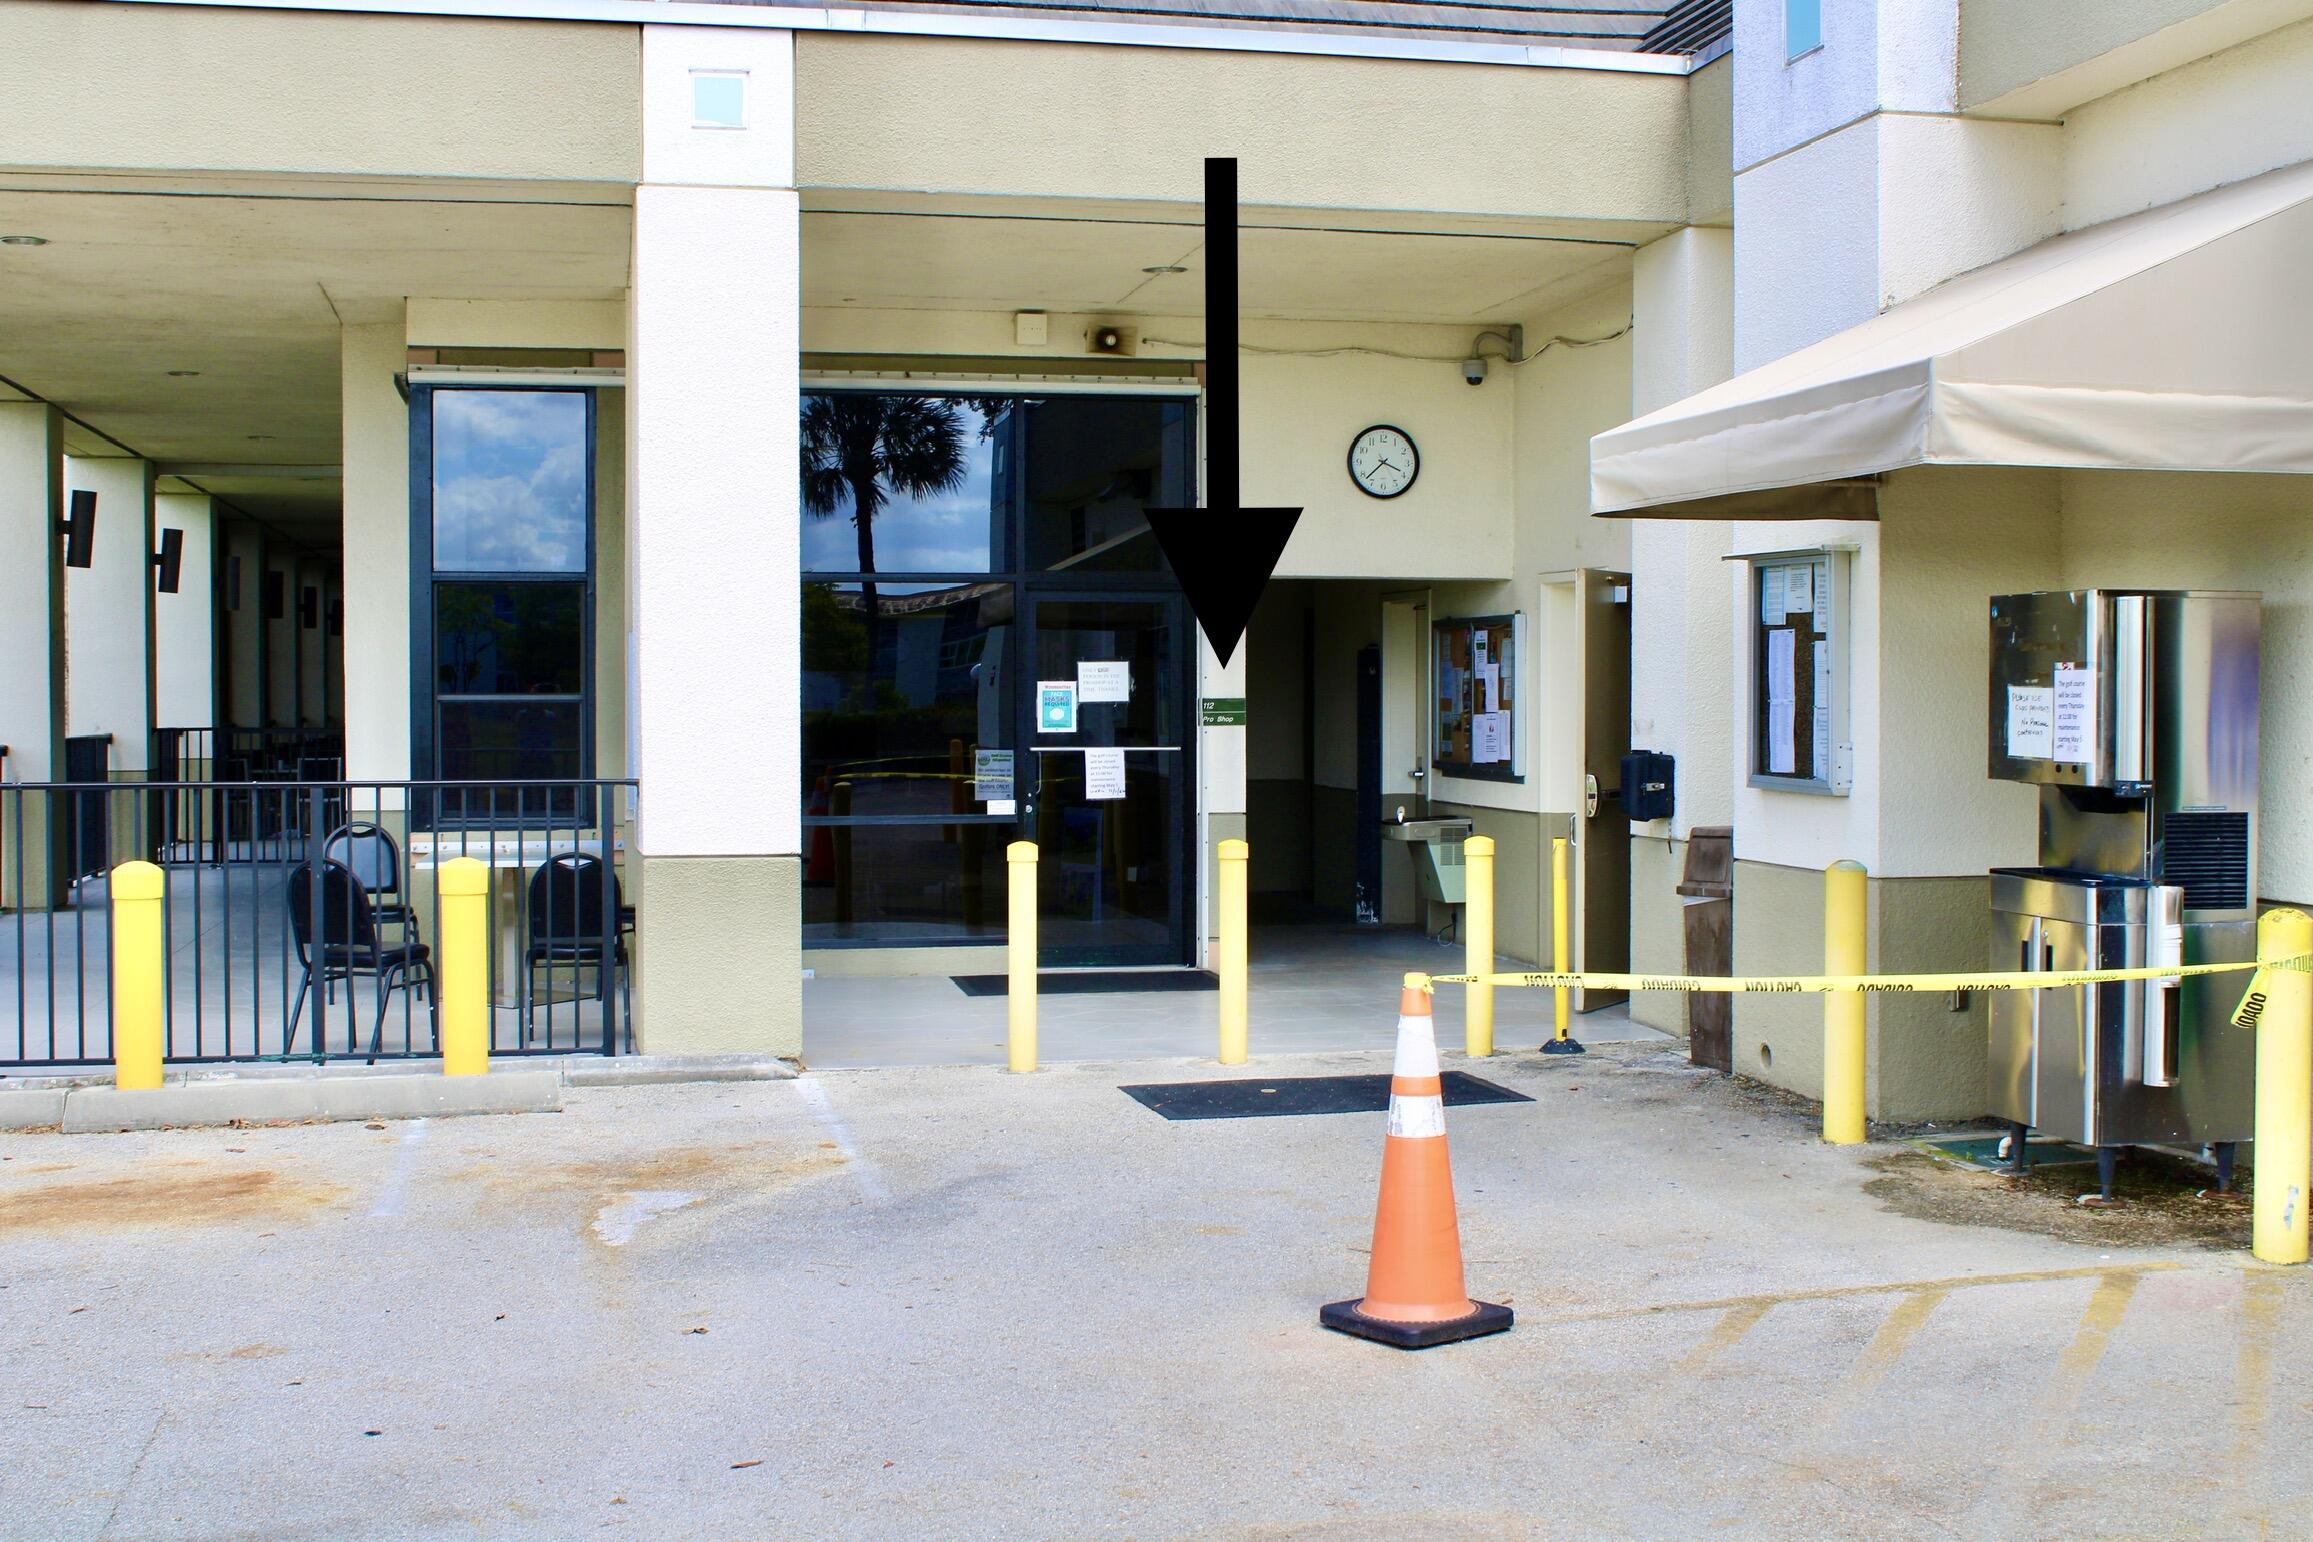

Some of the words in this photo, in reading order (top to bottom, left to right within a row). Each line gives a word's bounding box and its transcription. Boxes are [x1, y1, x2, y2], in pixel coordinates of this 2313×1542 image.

[1369, 437, 1375, 446] 11
[1380, 434, 1388, 443] 12
[1217, 715, 1233, 723] Shop
